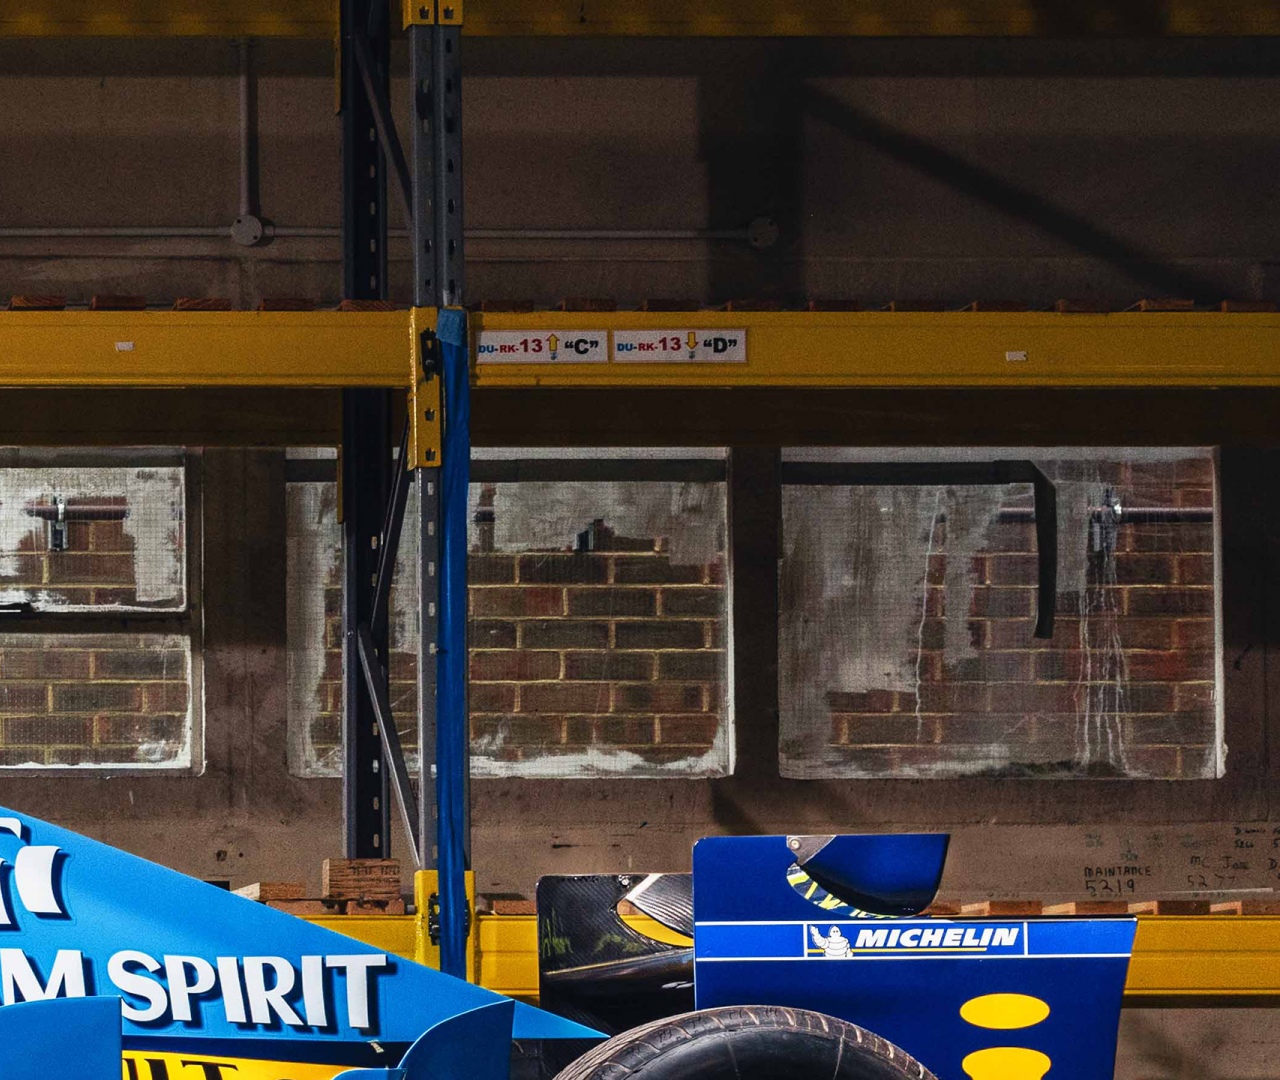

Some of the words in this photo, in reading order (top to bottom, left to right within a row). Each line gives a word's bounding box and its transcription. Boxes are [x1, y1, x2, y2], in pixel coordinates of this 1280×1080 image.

[478, 338, 543, 354] DU-RK-13
[616, 337, 681, 352] DU-RK-13
[855, 928, 1019, 947] MICHELIN
[107, 951, 387, 1029] SPIRIT
